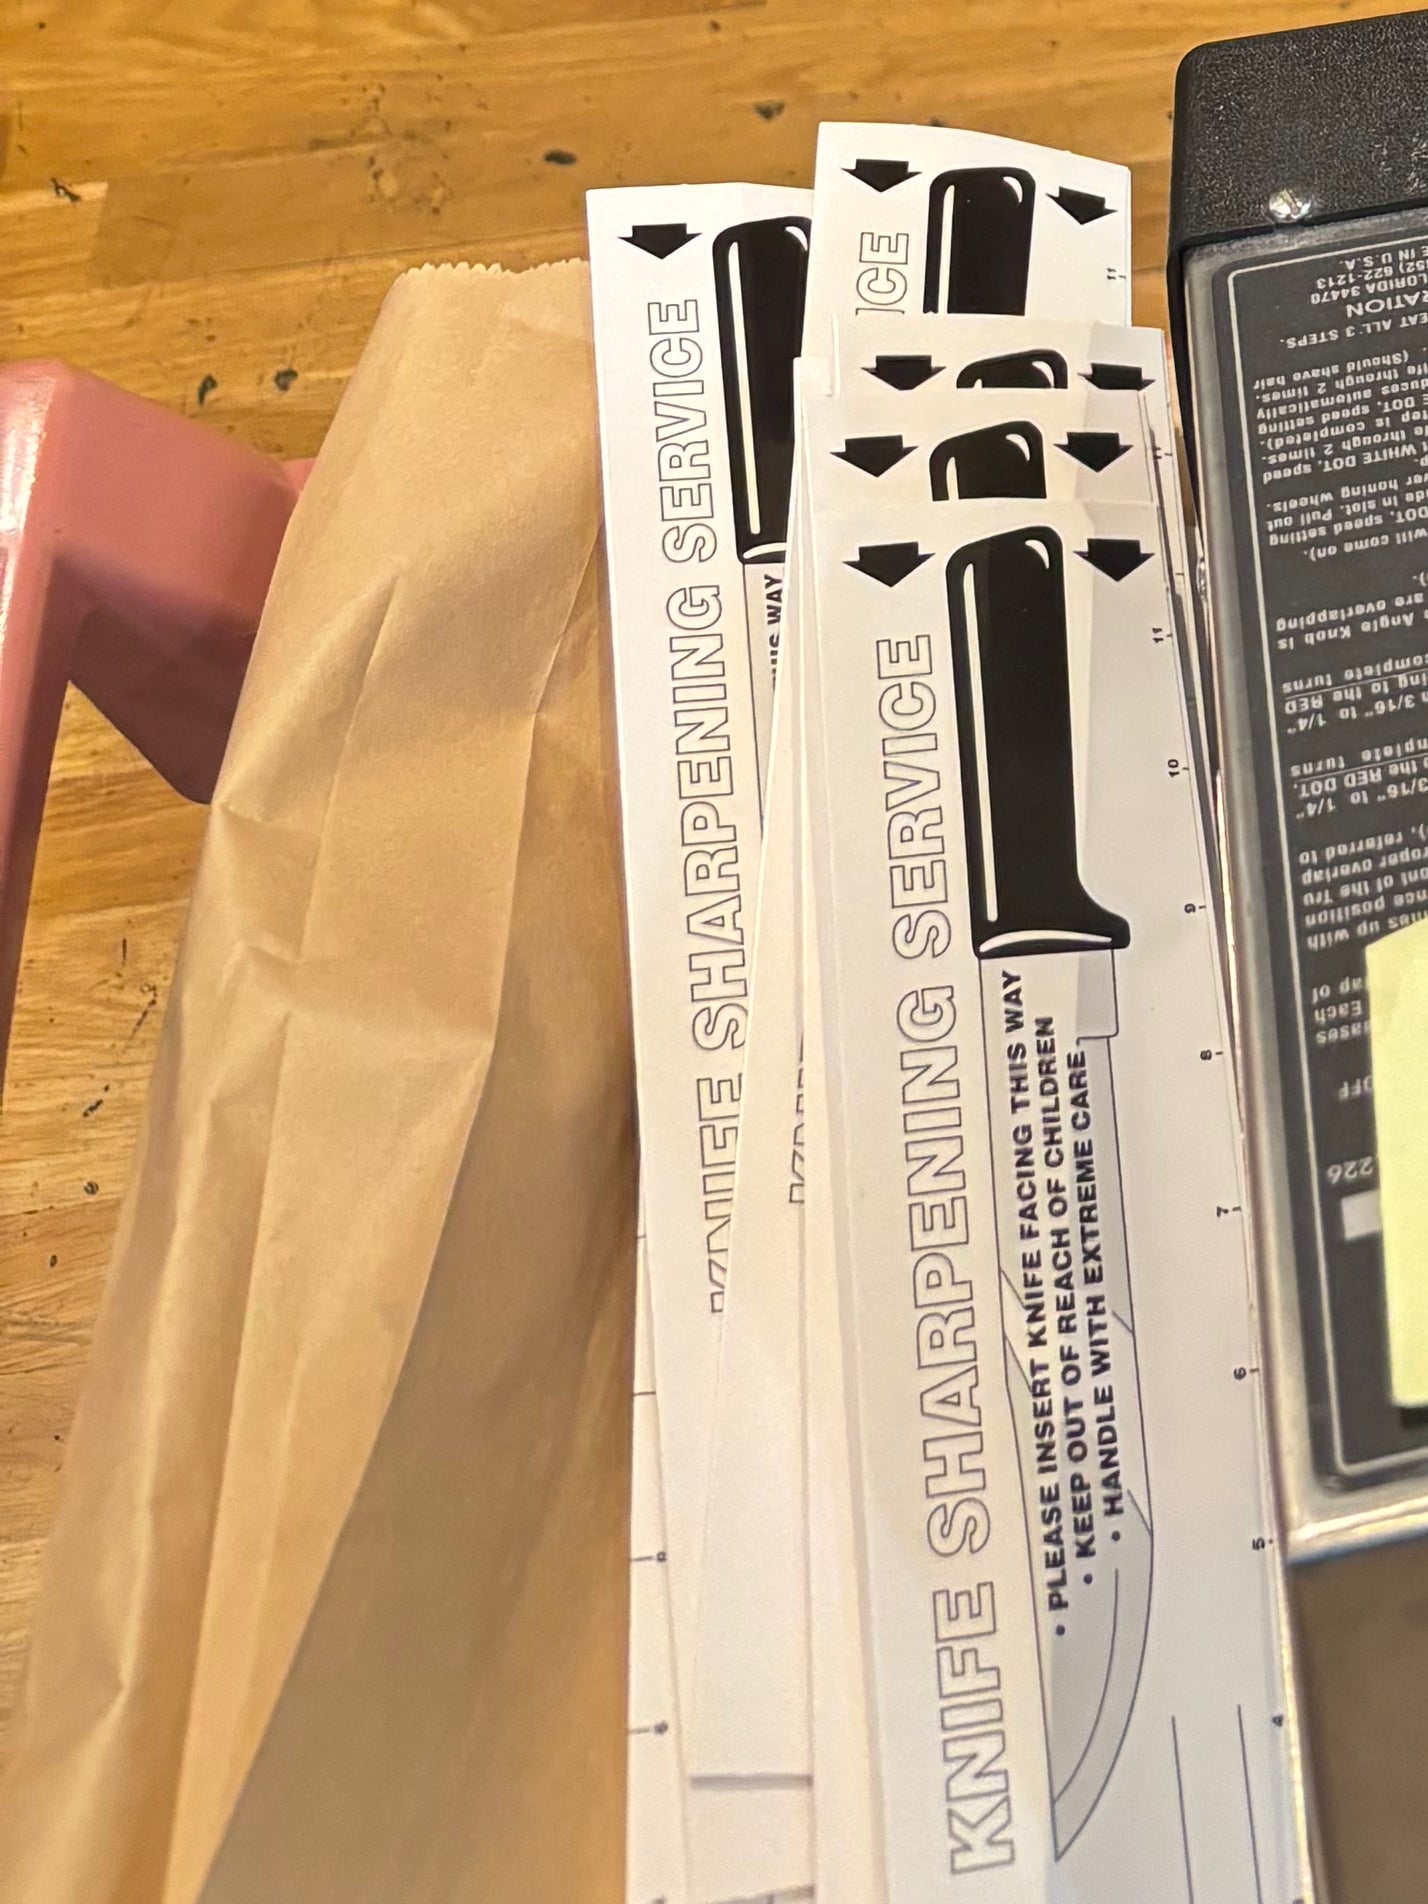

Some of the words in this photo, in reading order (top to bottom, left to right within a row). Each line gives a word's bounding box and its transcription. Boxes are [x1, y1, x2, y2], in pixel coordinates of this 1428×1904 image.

[646, 298, 719, 564] SERVICE
[665, 584, 750, 1051] SHARPENING
[877, 633, 952, 959] SERVICE
[1002, 969, 1025, 1034] WAY
[1007, 1041, 1030, 1114] THIS
[1034, 1016, 1065, 1169] CHILDREN
[1067, 1051, 1091, 1130] CARE
[1012, 1124, 1041, 1239] FACING
[1046, 1178, 1068, 1216] OF
[1073, 1141, 1103, 1284] EXTREME
[895, 975, 988, 1554] SHARPENING
[1021, 1249, 1050, 1349] KNIFE
[1048, 1228, 1078, 1334] REACH
[1058, 1344, 1081, 1385] OF
[1086, 1295, 1110, 1376] WITH
[1029, 1358, 1059, 1474] INSERT
[1065, 1399, 1087, 1464] OUT
[1094, 1386, 1124, 1516] HANDLE
[1038, 1483, 1069, 1611] PLEASE
[1070, 1473, 1096, 1559] KEEP
[932, 1579, 1013, 1876] KNIFE
